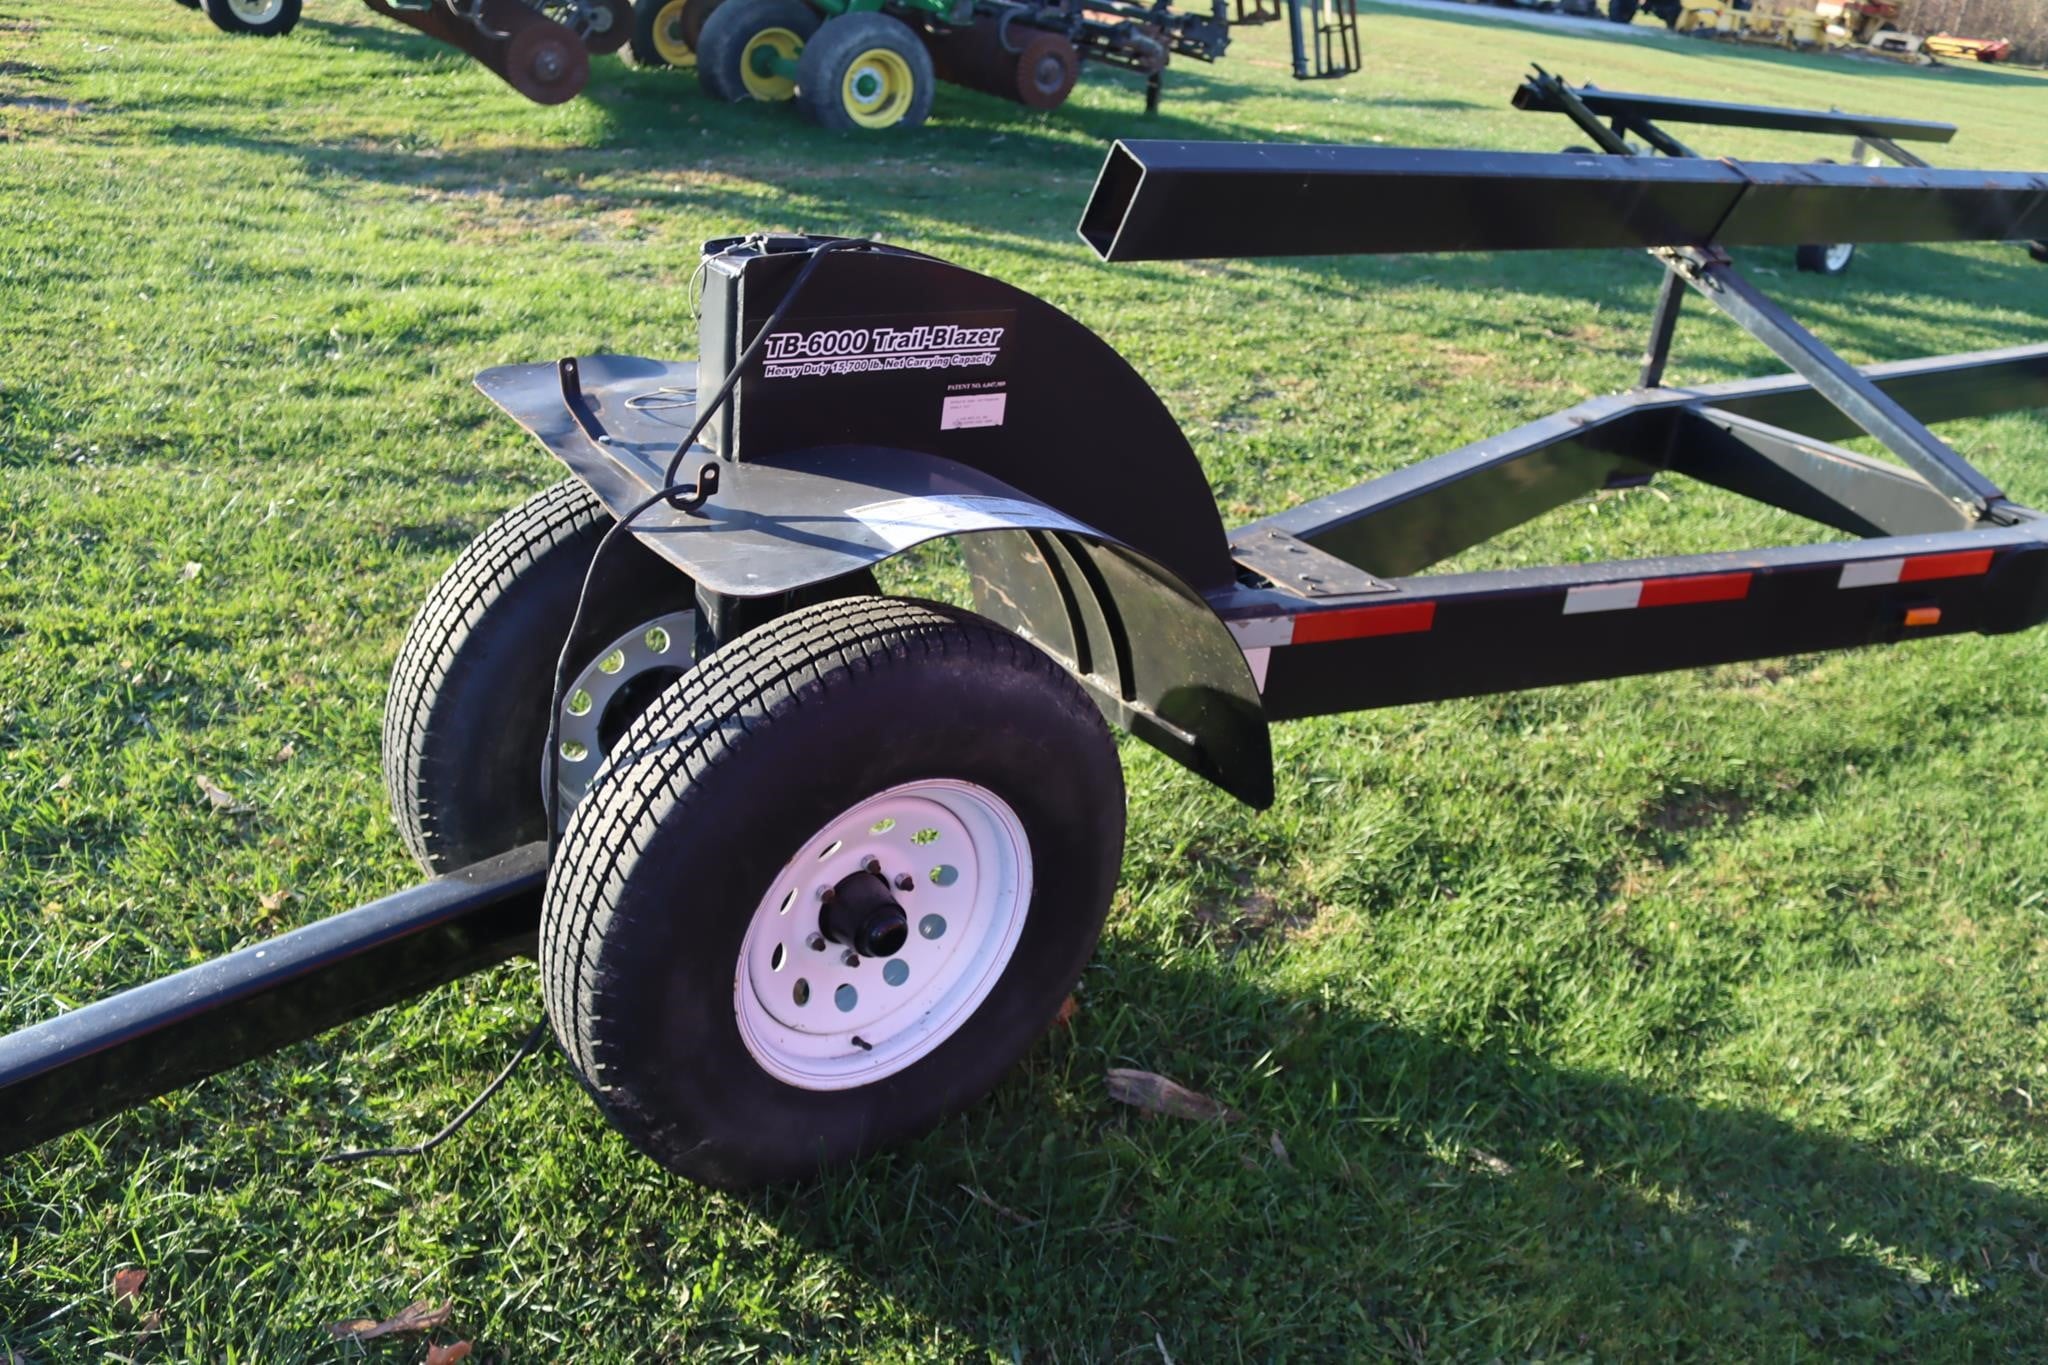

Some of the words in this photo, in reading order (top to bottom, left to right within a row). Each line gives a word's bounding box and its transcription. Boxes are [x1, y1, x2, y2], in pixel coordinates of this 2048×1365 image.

[764, 331, 869, 359] TB-6000
[872, 325, 1004, 352] Trail-Blazer
[764, 363, 802, 378] Heavy
[802, 361, 831, 377] Duty
[831, 359, 868, 375] 15,700
[884, 357, 906, 370] Net
[906, 355, 950, 369] Carrying
[951, 352, 996, 367] Capacity
